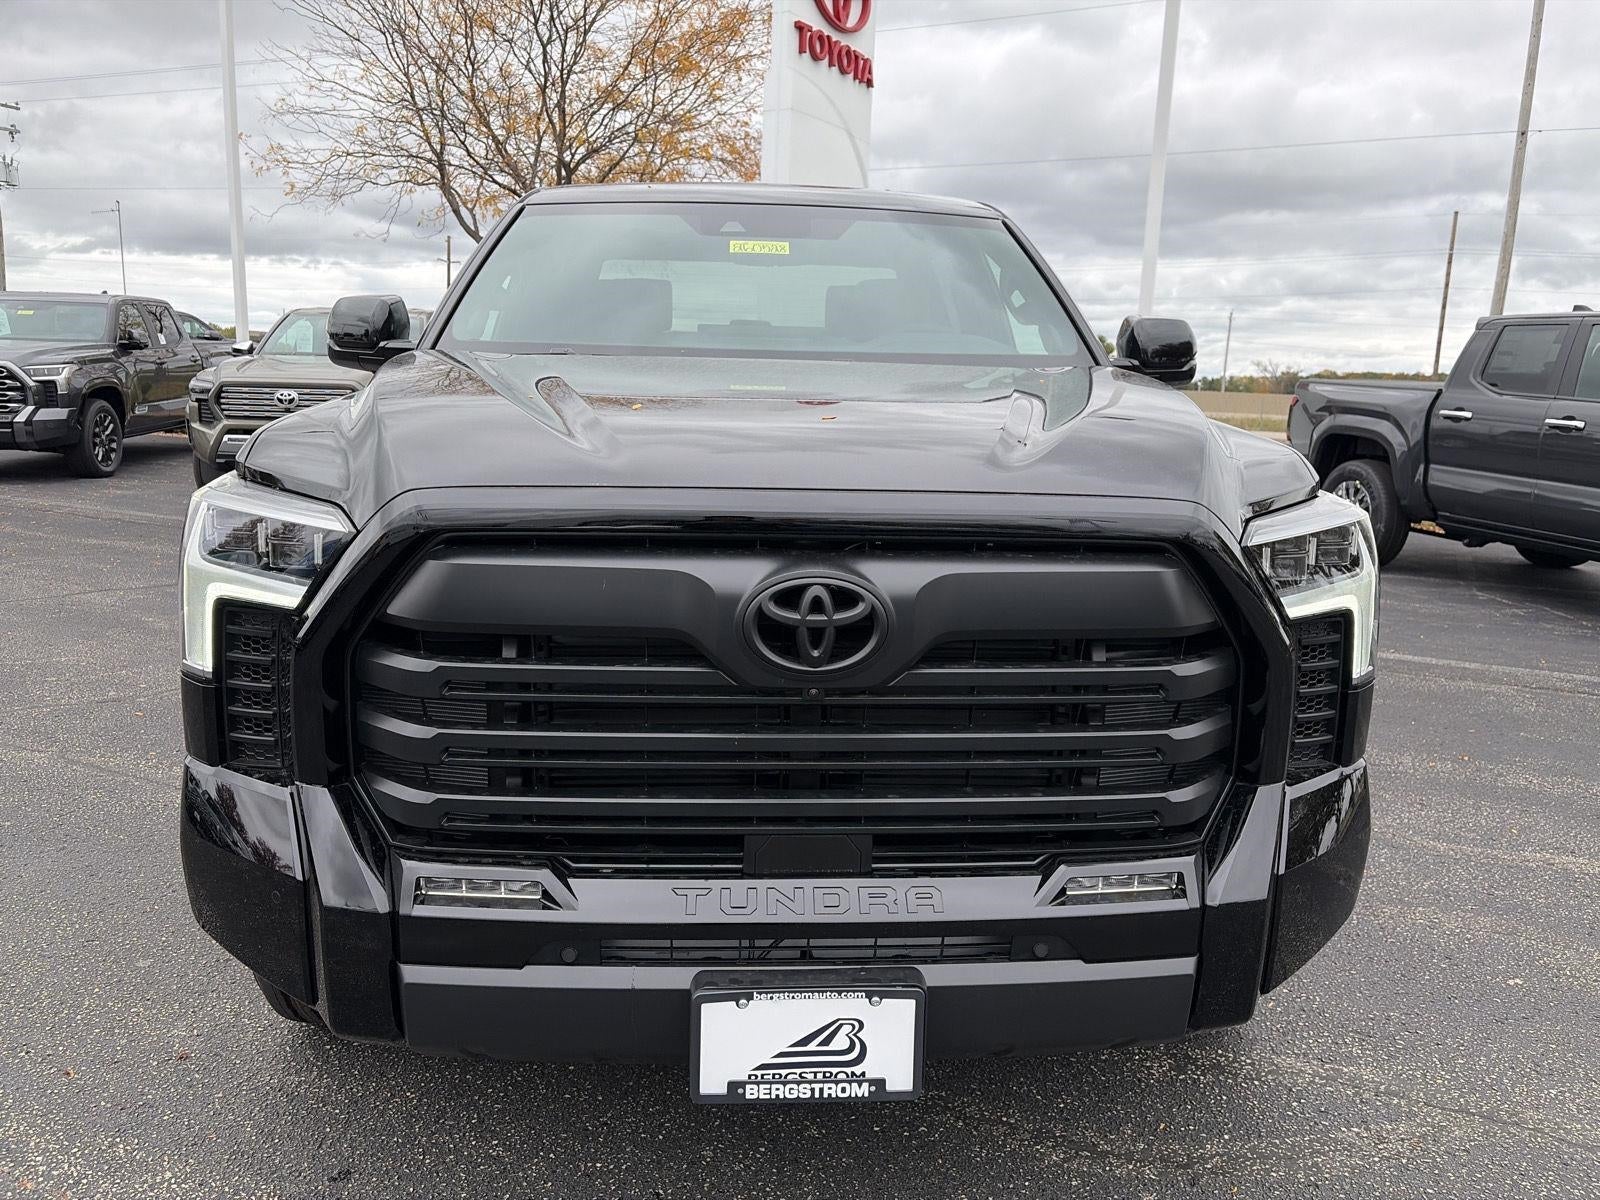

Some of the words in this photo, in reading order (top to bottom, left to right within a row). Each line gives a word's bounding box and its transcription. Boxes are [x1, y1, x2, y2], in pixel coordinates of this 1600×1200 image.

[794, 20, 874, 88] TOYOTA
[671, 886, 944, 916] TUNDRA
[753, 991, 866, 1001] bergstromauto.com
[745, 1082, 870, 1099] BERGSTROM
